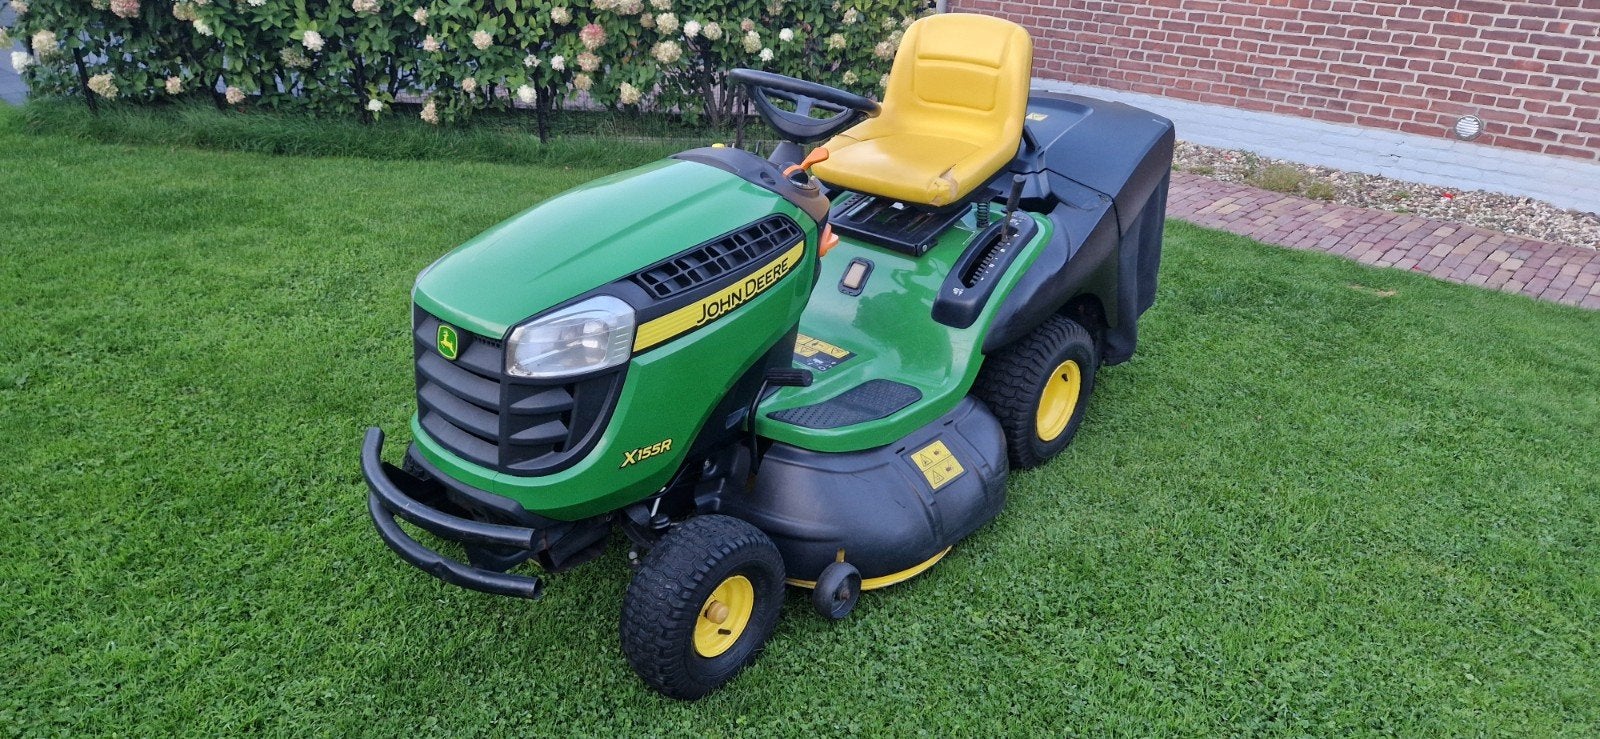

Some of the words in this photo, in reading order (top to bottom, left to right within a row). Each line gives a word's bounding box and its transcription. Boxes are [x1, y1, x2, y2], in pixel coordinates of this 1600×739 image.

[697, 288, 742, 324] JOHN
[745, 258, 789, 298] DEERE
[620, 438, 672, 468] X155R
